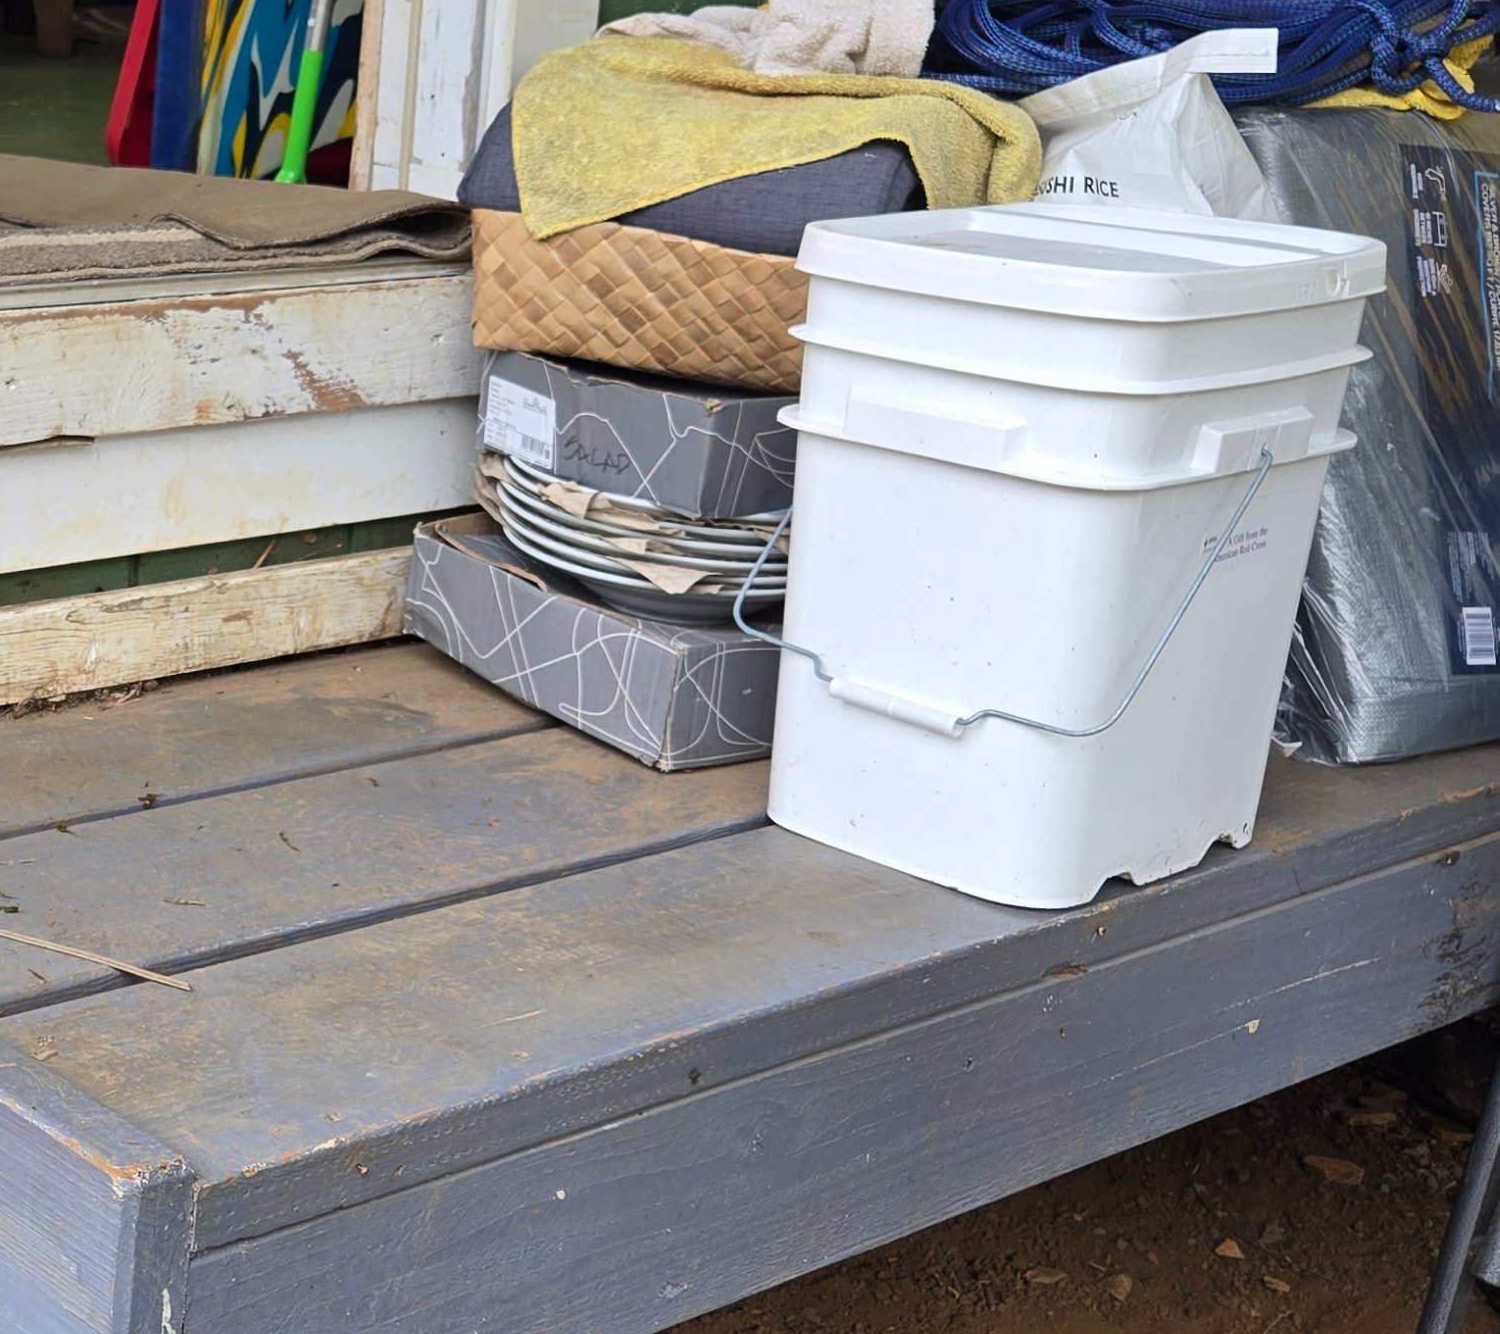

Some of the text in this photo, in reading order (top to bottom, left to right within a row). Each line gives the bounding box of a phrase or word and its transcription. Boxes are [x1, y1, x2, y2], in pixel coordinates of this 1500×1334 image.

[1084, 176, 1119, 198] RICE
[563, 435, 631, 475] SALAD
[1245, 530, 1259, 542] from
[1260, 527, 1268, 537] the
[1240, 544, 1251, 556] Red
